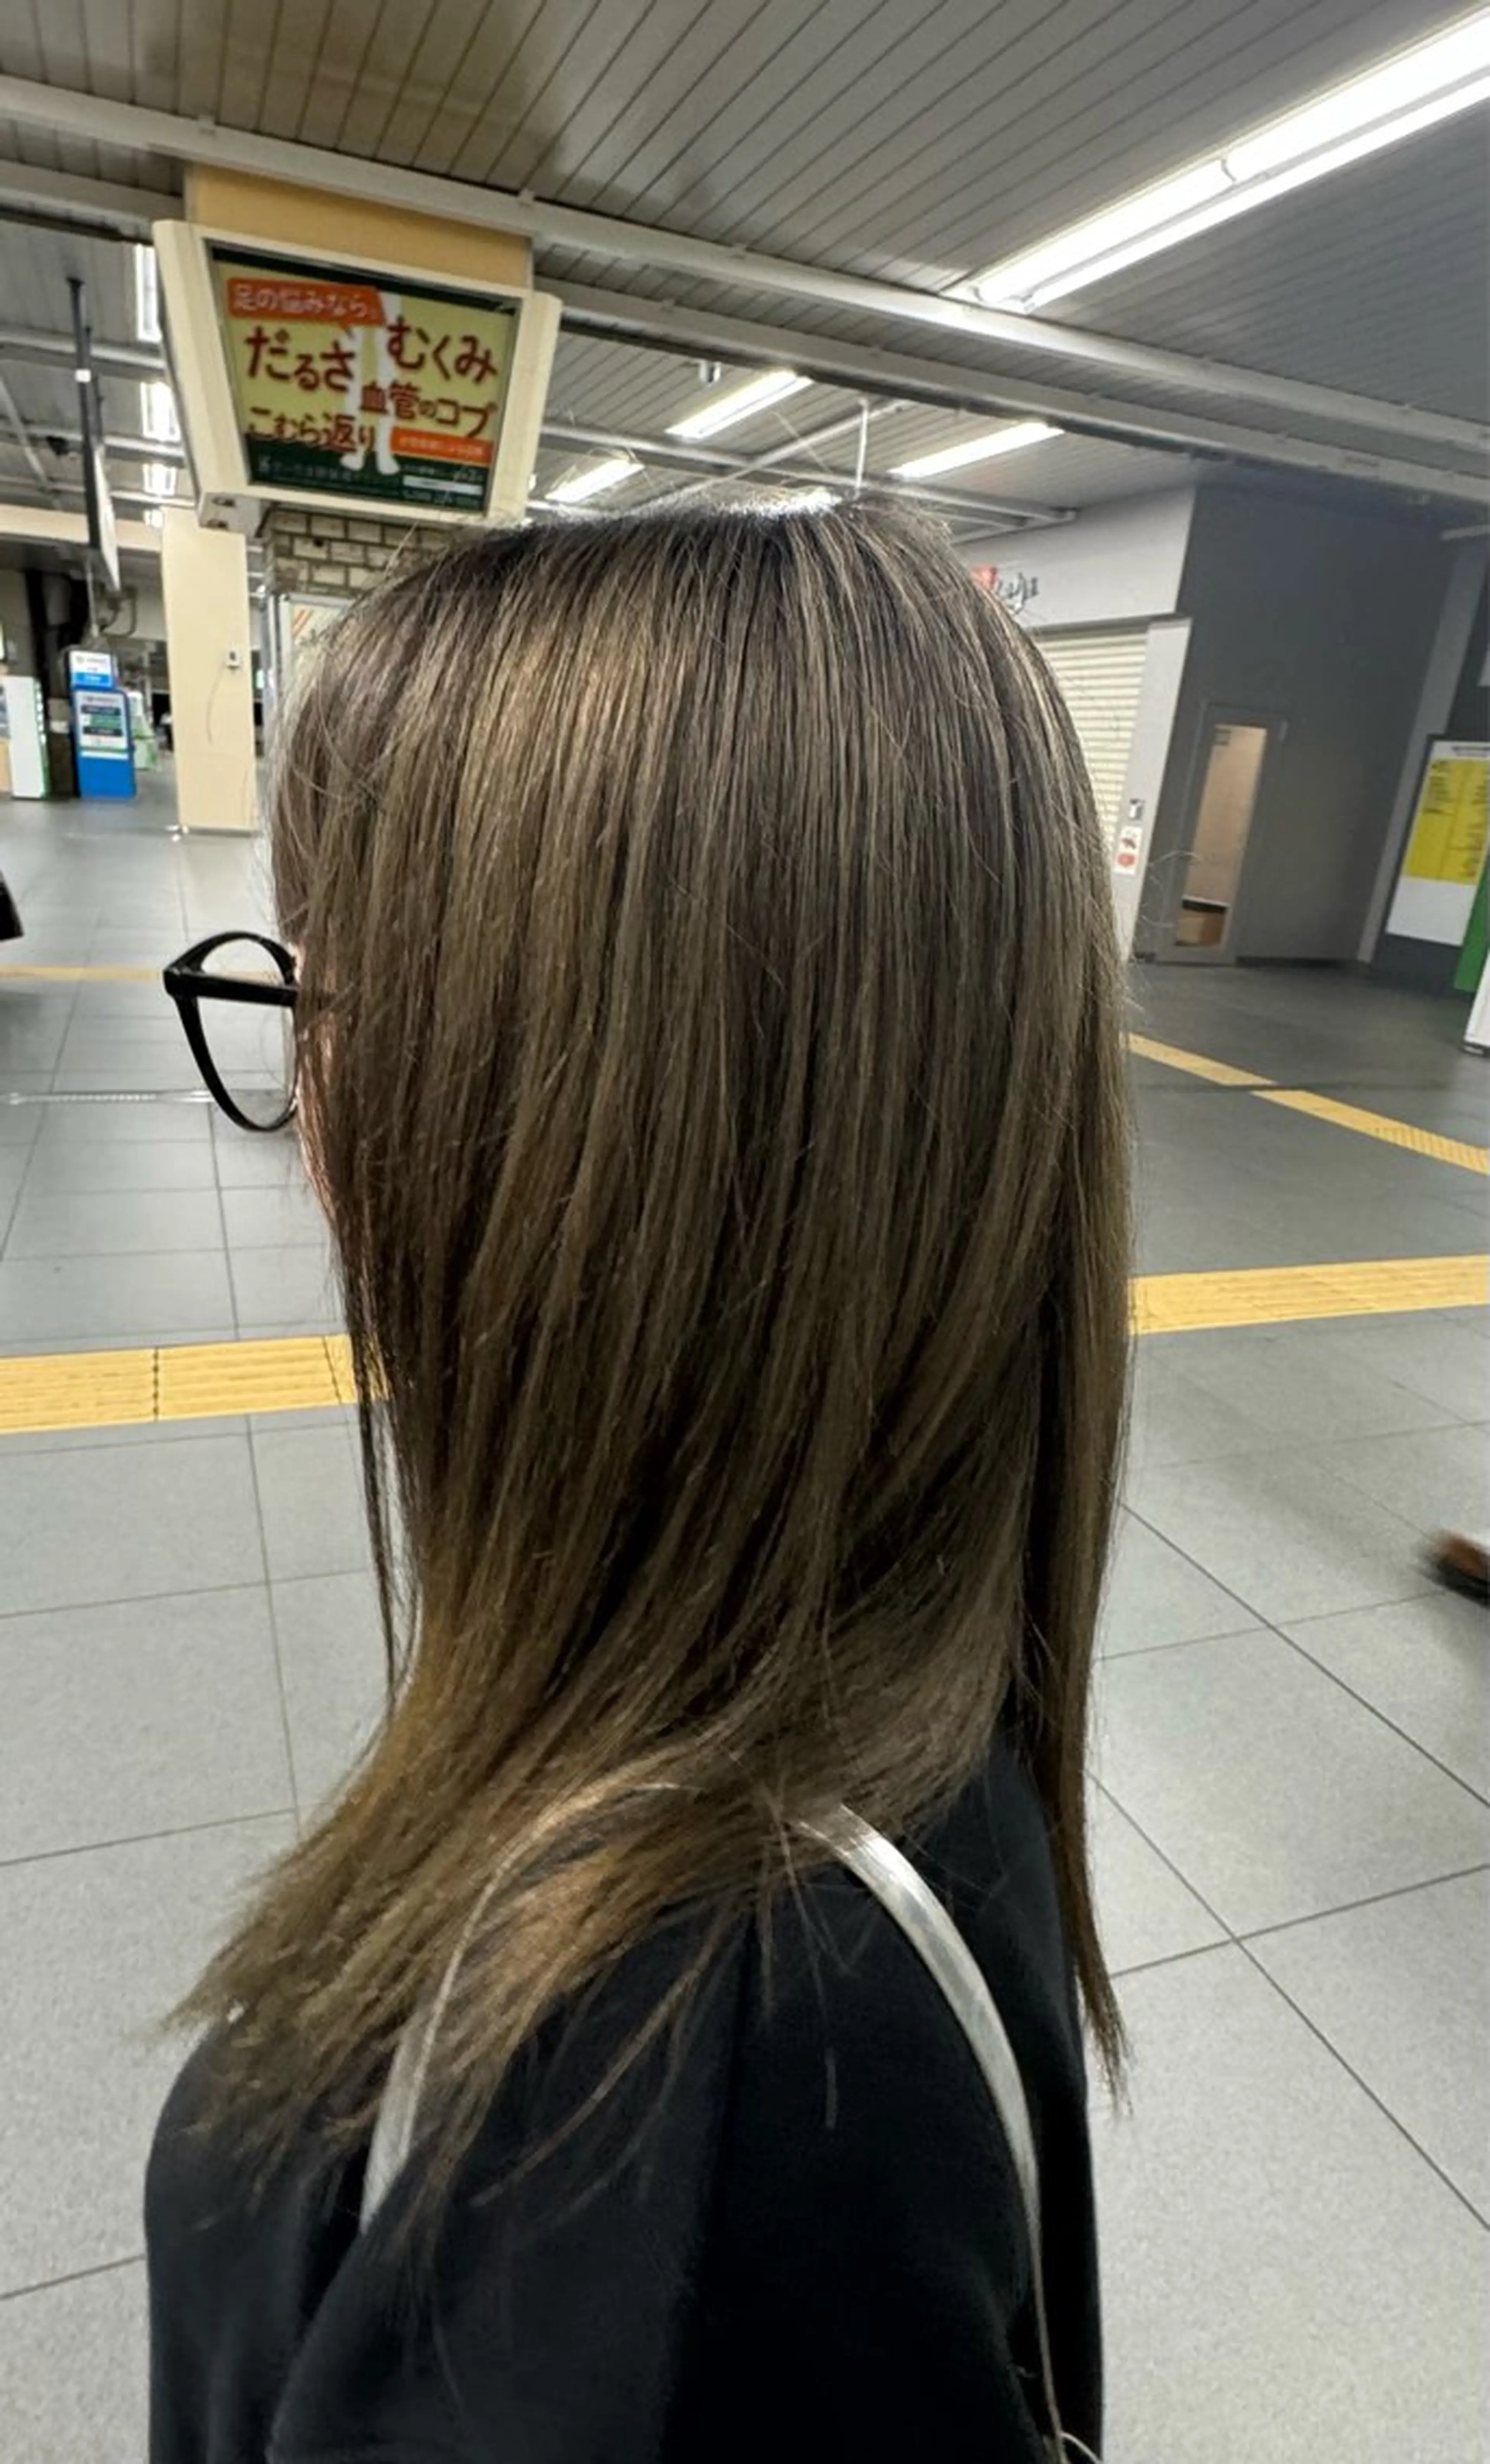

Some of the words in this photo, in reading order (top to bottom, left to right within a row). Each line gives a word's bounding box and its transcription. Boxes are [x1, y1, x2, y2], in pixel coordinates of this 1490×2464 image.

[244, 325, 355, 393] だるさ
[386, 314, 497, 384] むくみ
[248, 405, 376, 453] こむら返り
